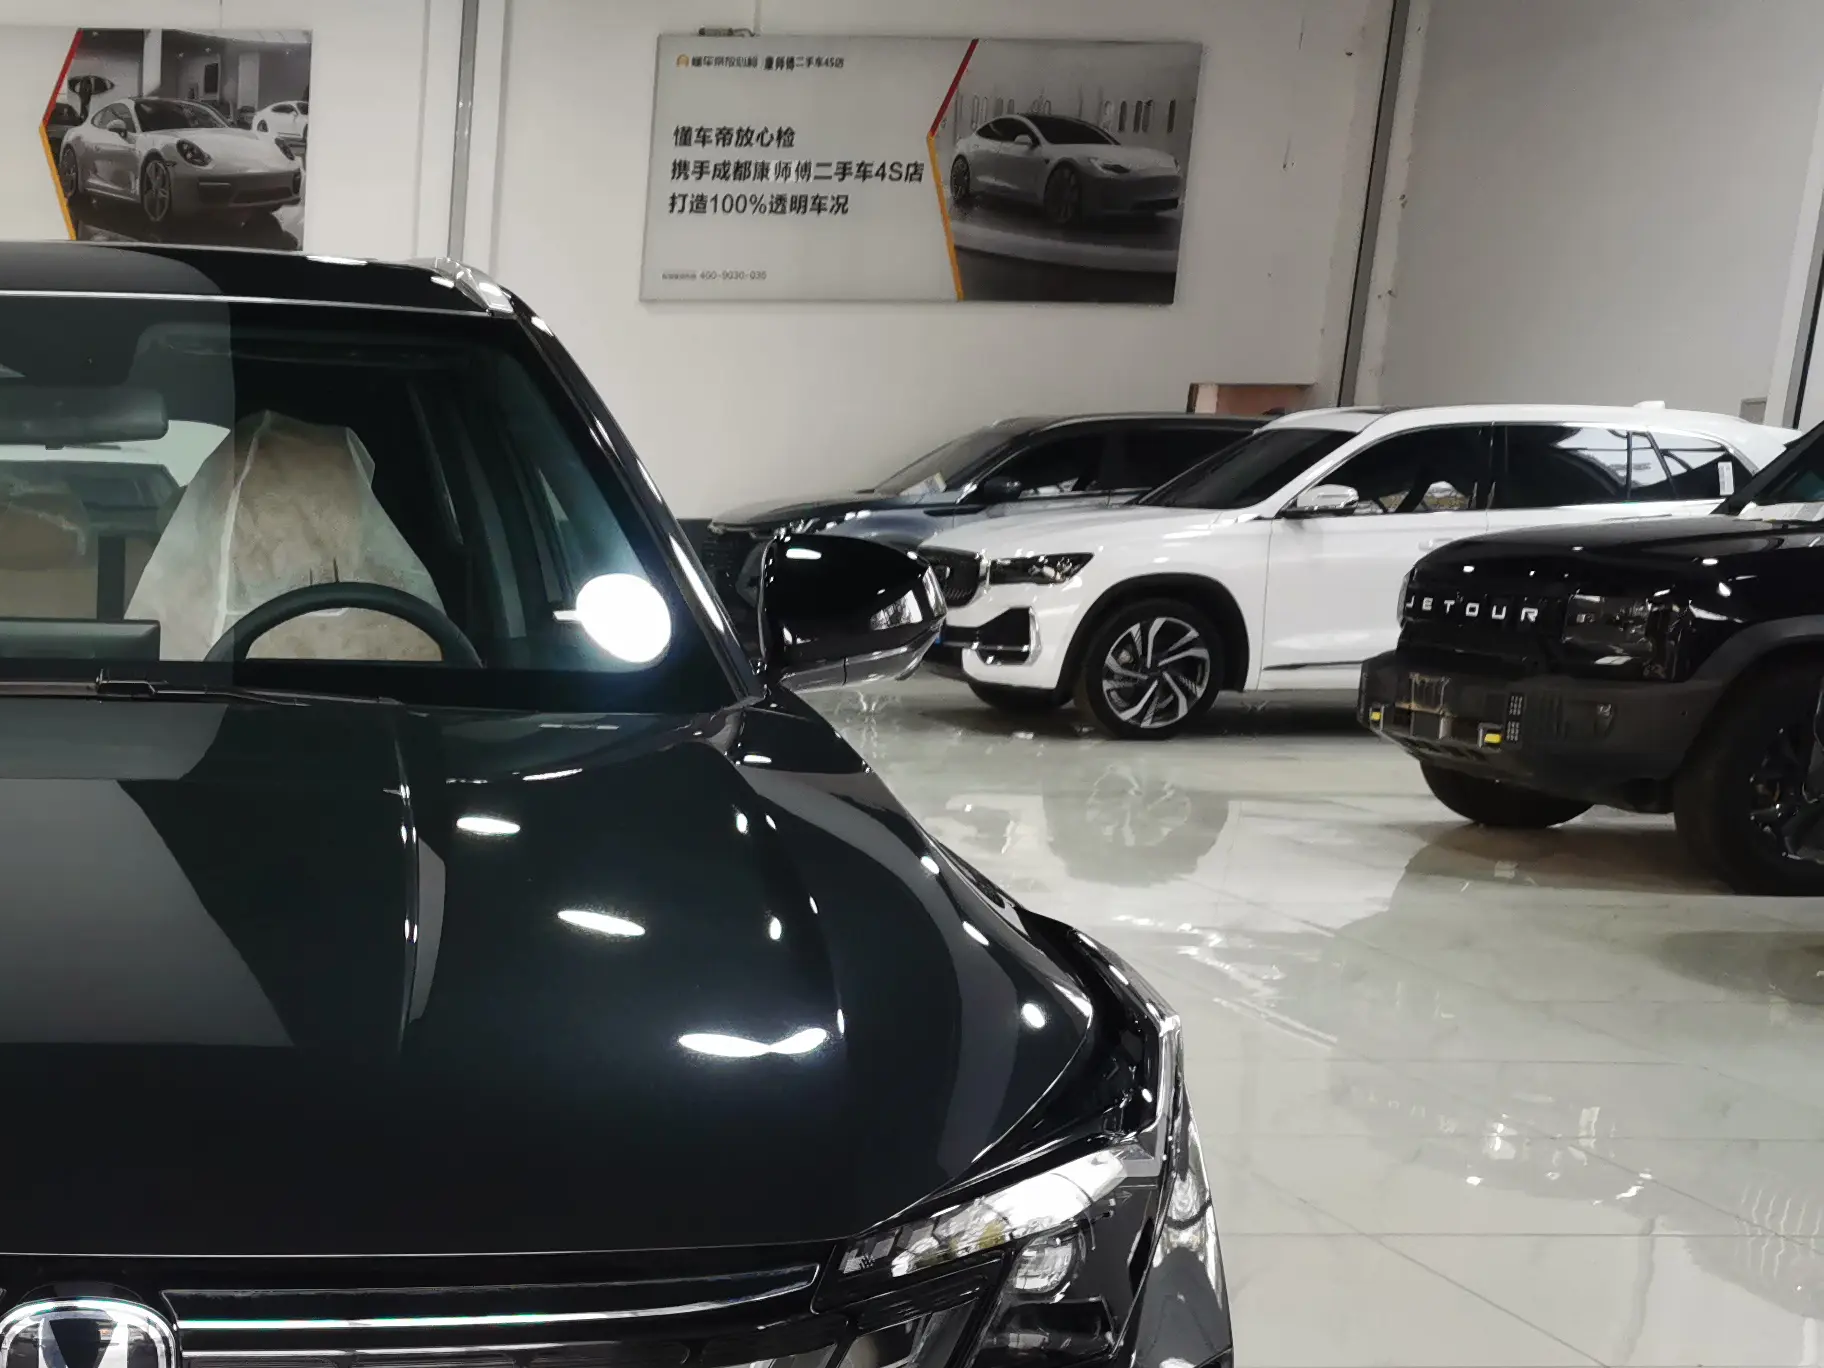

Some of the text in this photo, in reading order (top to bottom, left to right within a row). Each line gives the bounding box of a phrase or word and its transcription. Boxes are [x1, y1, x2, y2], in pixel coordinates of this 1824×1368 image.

[674, 126, 795, 148] 懂车帝放心检
[671, 159, 925, 182] 携手成都康师傅二手车4S店
[669, 193, 849, 215] 打造100%透明车况
[1406, 596, 1539, 622] JETOUR
